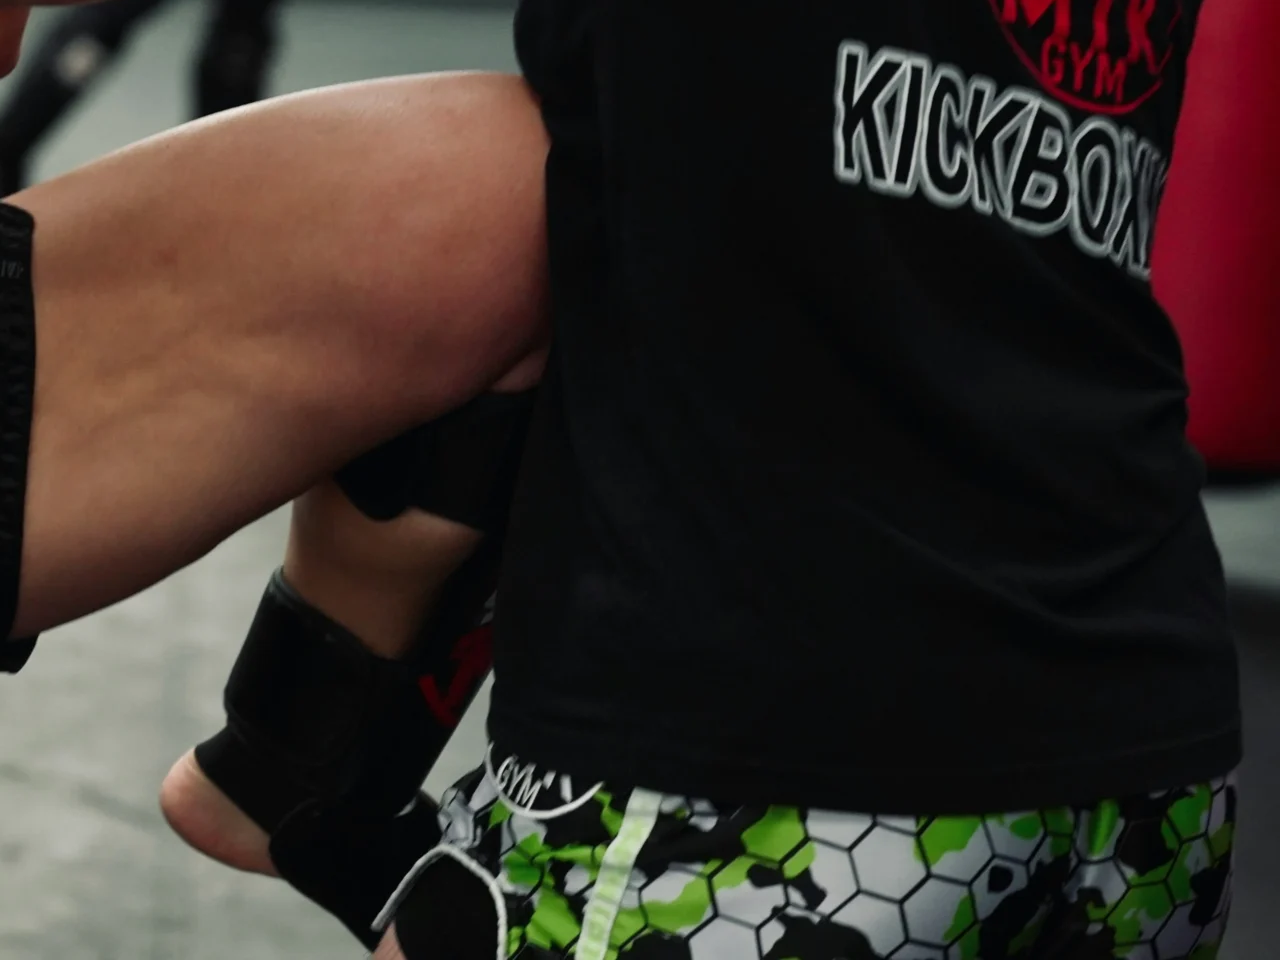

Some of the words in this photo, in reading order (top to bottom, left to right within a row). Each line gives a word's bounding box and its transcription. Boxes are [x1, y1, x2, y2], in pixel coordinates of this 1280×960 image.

[1041, 35, 1128, 104] GYM
[833, 38, 1167, 281] KICKBOX
[496, 754, 543, 813] GYM
